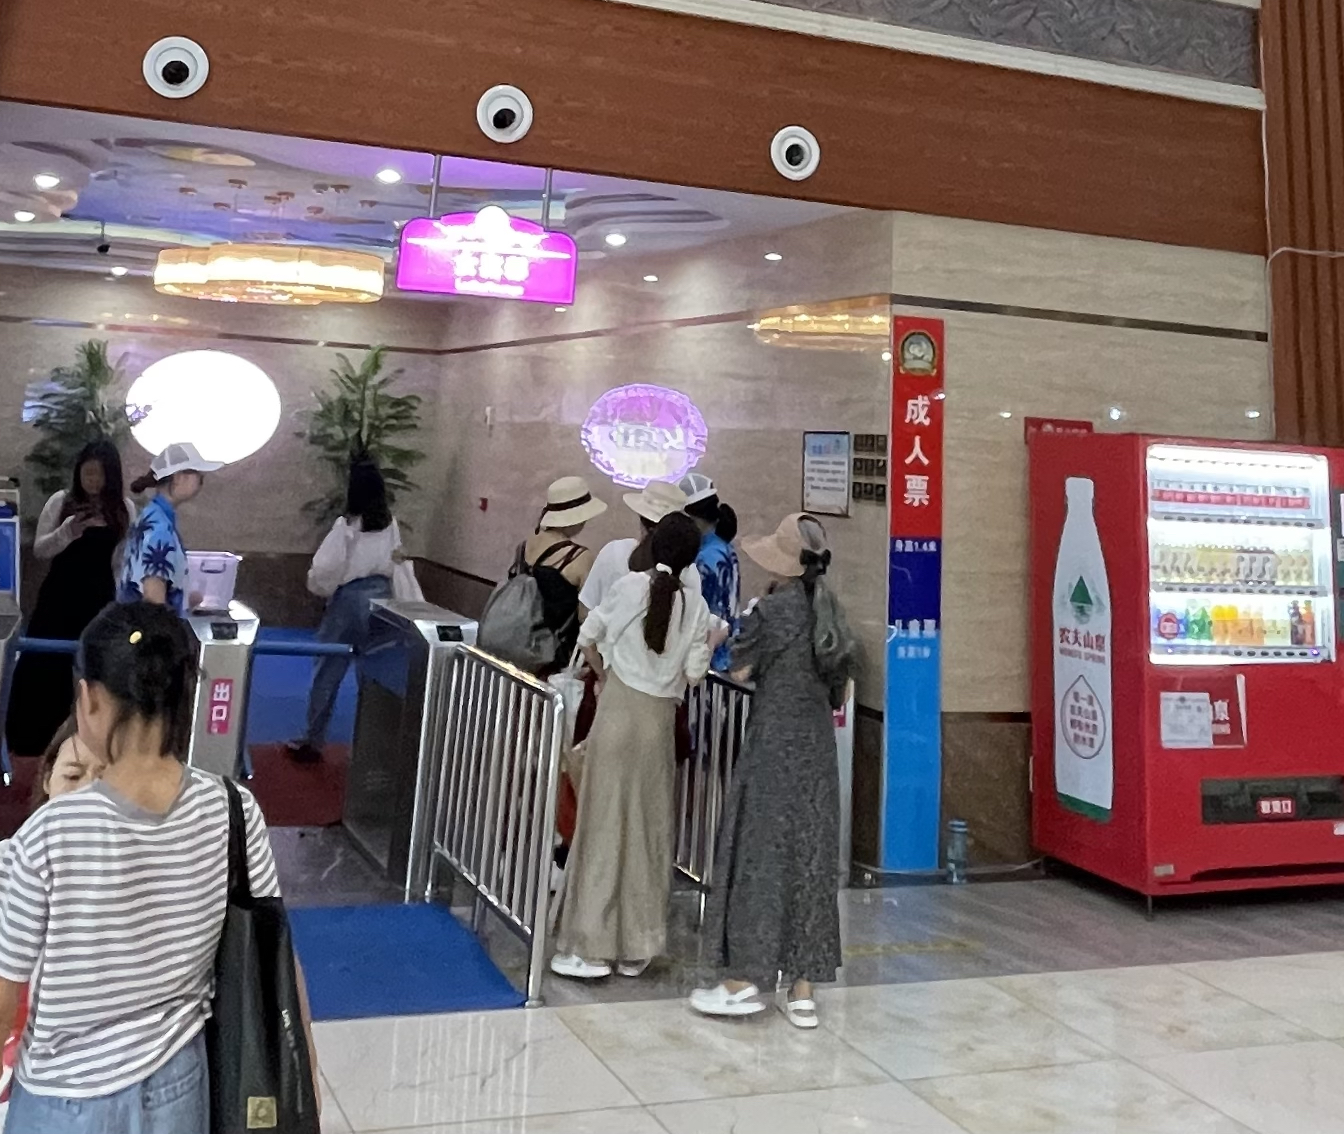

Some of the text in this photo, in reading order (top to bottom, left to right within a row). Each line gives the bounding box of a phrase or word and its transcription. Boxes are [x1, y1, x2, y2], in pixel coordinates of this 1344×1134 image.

[904, 395, 931, 508] 成人票
[212, 682, 231, 722] 出口
